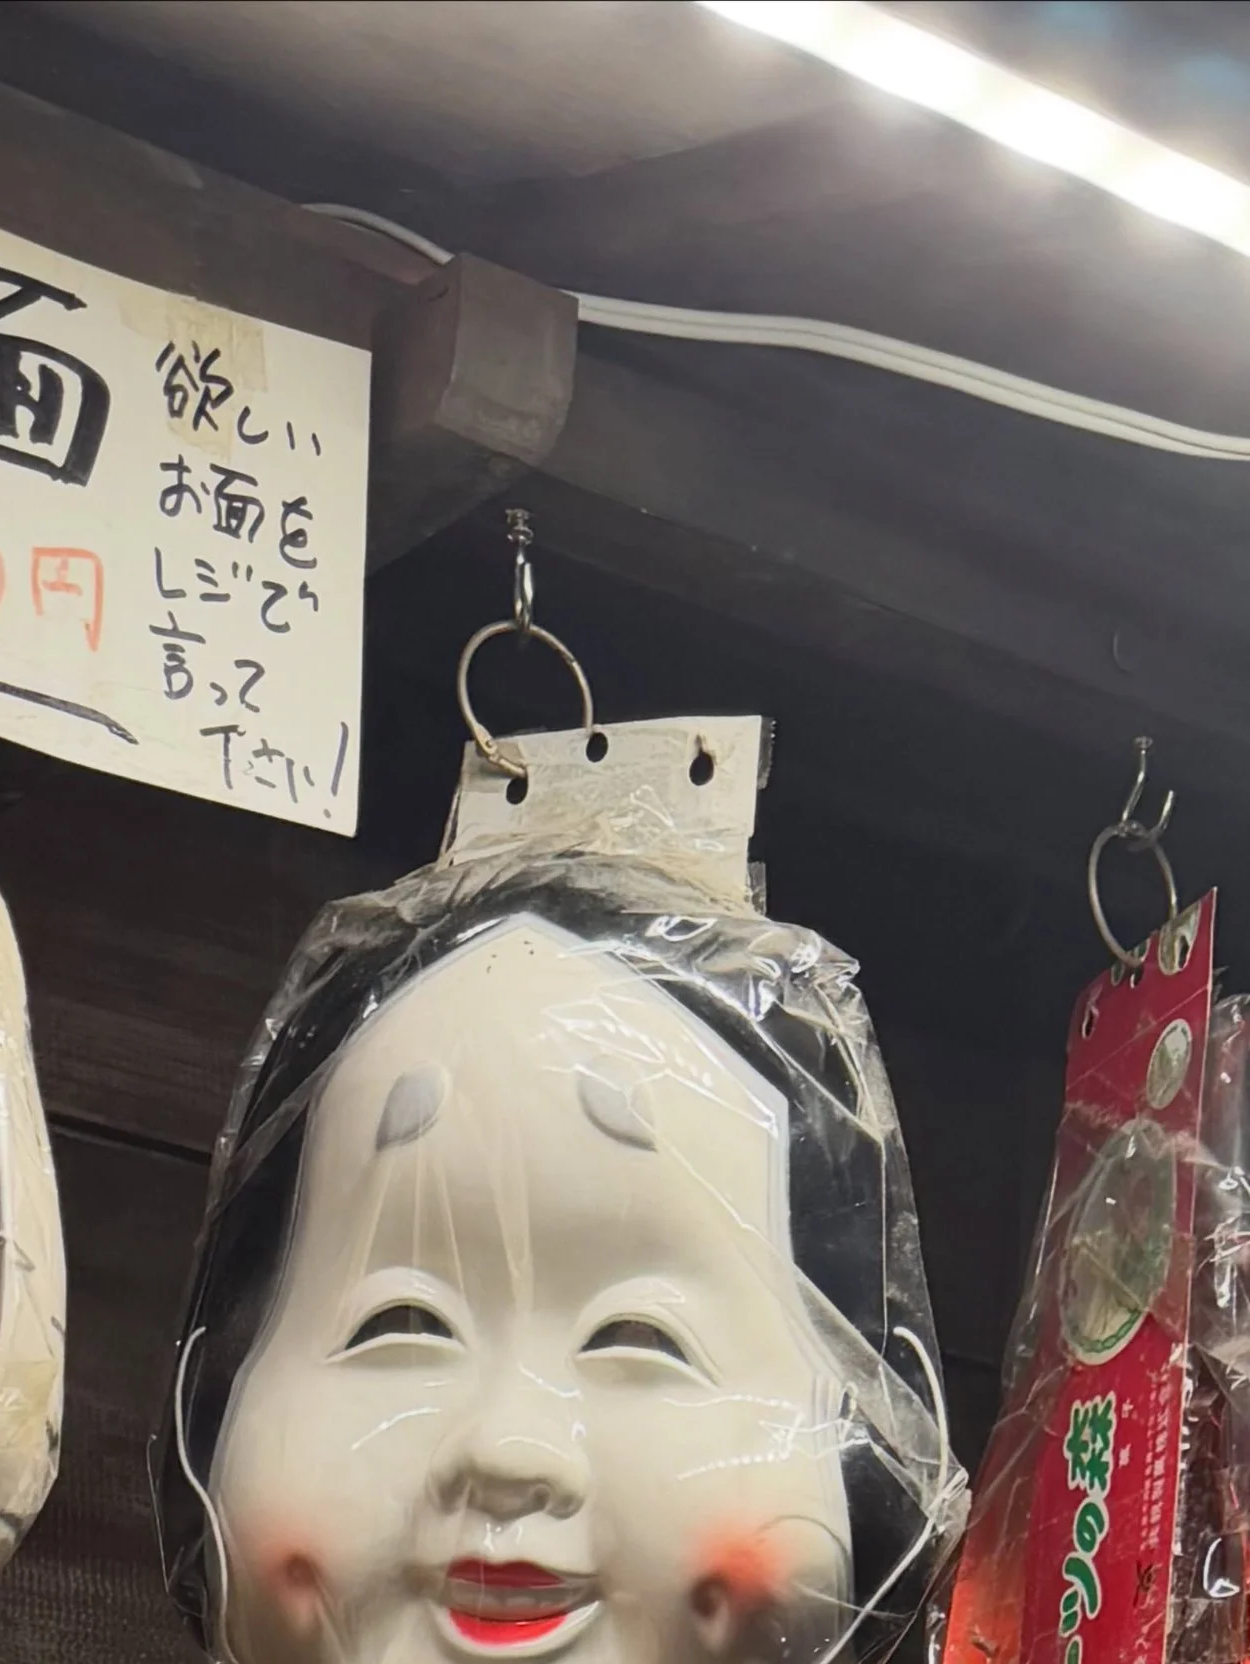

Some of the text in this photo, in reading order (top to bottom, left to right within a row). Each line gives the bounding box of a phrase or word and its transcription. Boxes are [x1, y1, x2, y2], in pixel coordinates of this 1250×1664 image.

[154, 339, 323, 457] 欲しい
[158, 454, 319, 570] お面を
[154, 548, 320, 633] レジで
[149, 612, 266, 714] 言って
